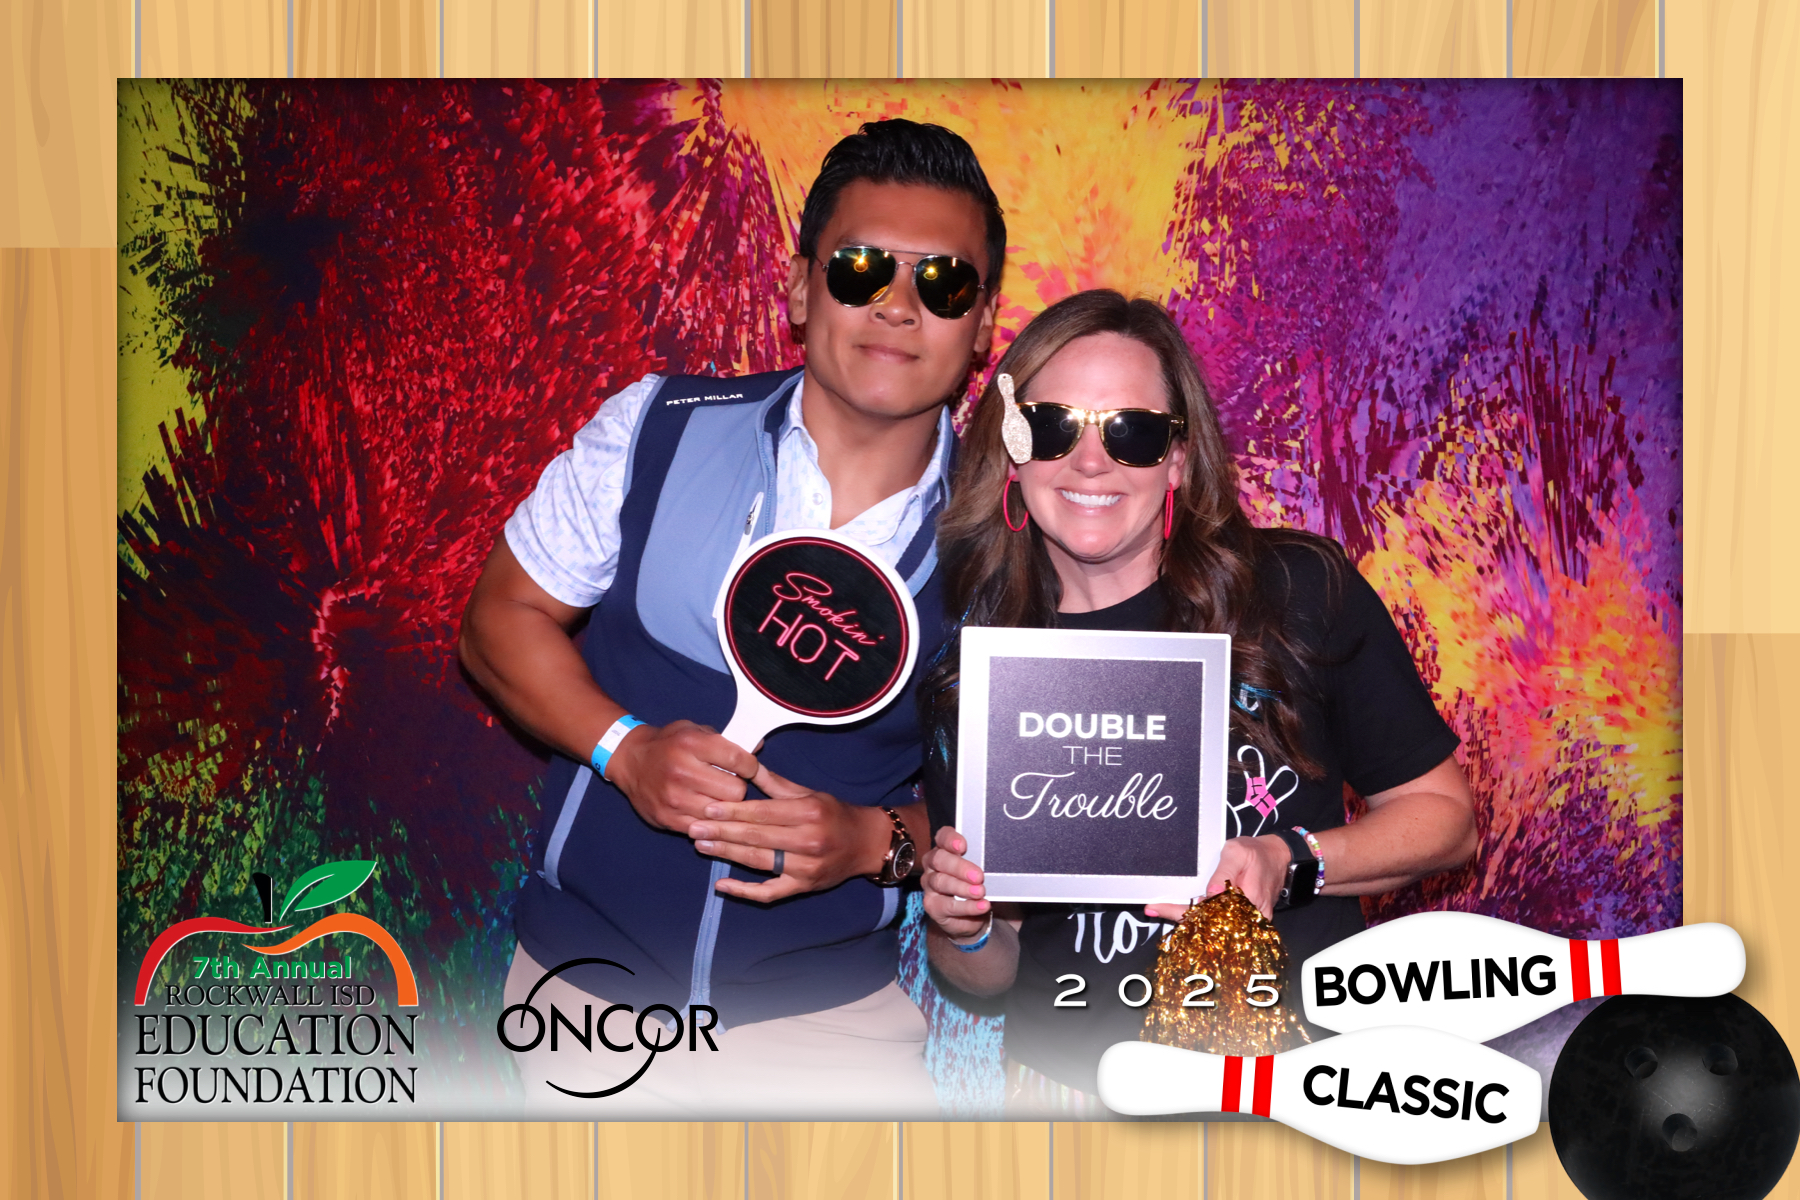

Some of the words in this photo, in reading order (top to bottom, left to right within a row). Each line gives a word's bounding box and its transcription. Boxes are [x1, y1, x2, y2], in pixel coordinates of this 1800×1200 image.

[666, 397, 701, 406] PETER
[704, 393, 744, 401] MILLAR
[772, 572, 885, 645] Smokin'
[758, 599, 860, 680] HOT
[1018, 712, 1167, 740] DOUBLE
[1062, 745, 1123, 766] THE
[1003, 771, 1178, 820] Trouble
